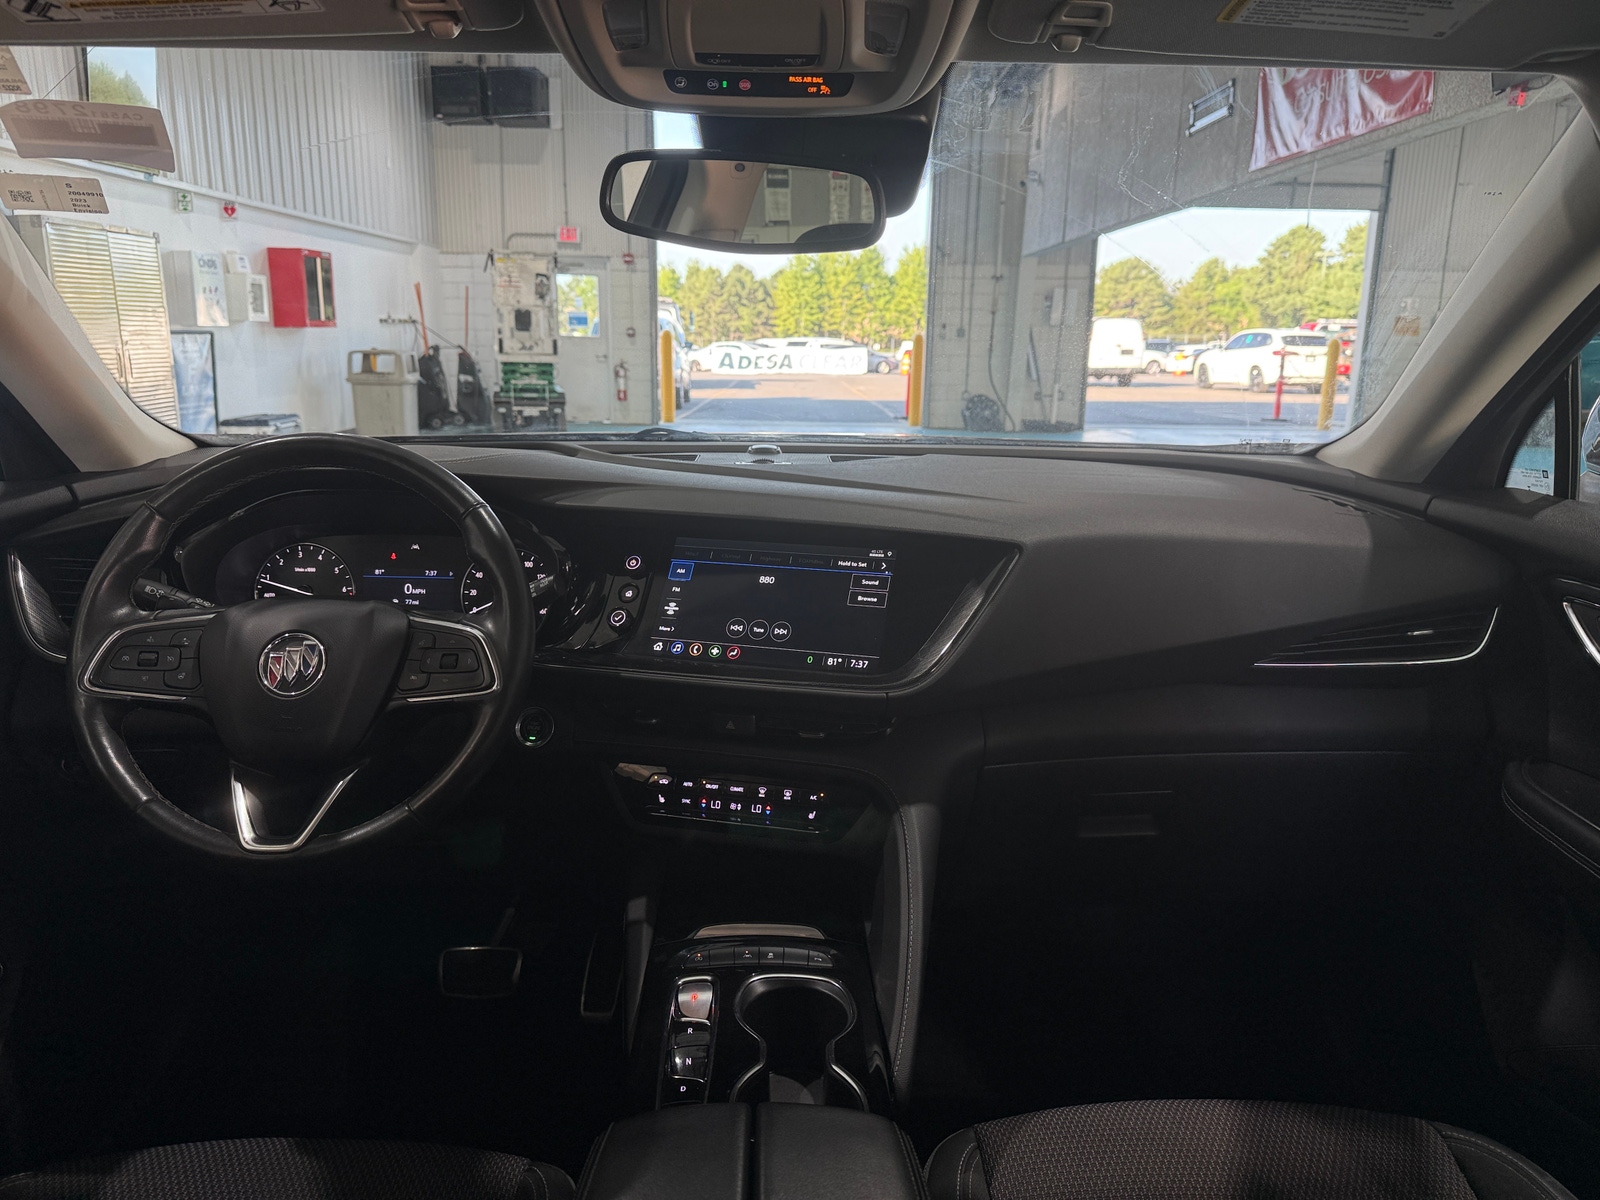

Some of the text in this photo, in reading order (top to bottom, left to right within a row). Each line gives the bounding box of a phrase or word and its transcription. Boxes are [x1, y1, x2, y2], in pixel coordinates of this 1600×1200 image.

[560, 227, 577, 241] EXIT
[718, 352, 863, 371] ADESA CLEAR
[759, 576, 775, 584] 880
[404, 583, 412, 595] 0
[850, 660, 869, 668] 7:37
[710, 800, 721, 809] LO
[751, 804, 762, 813] LO
[685, 1058, 692, 1066] N
